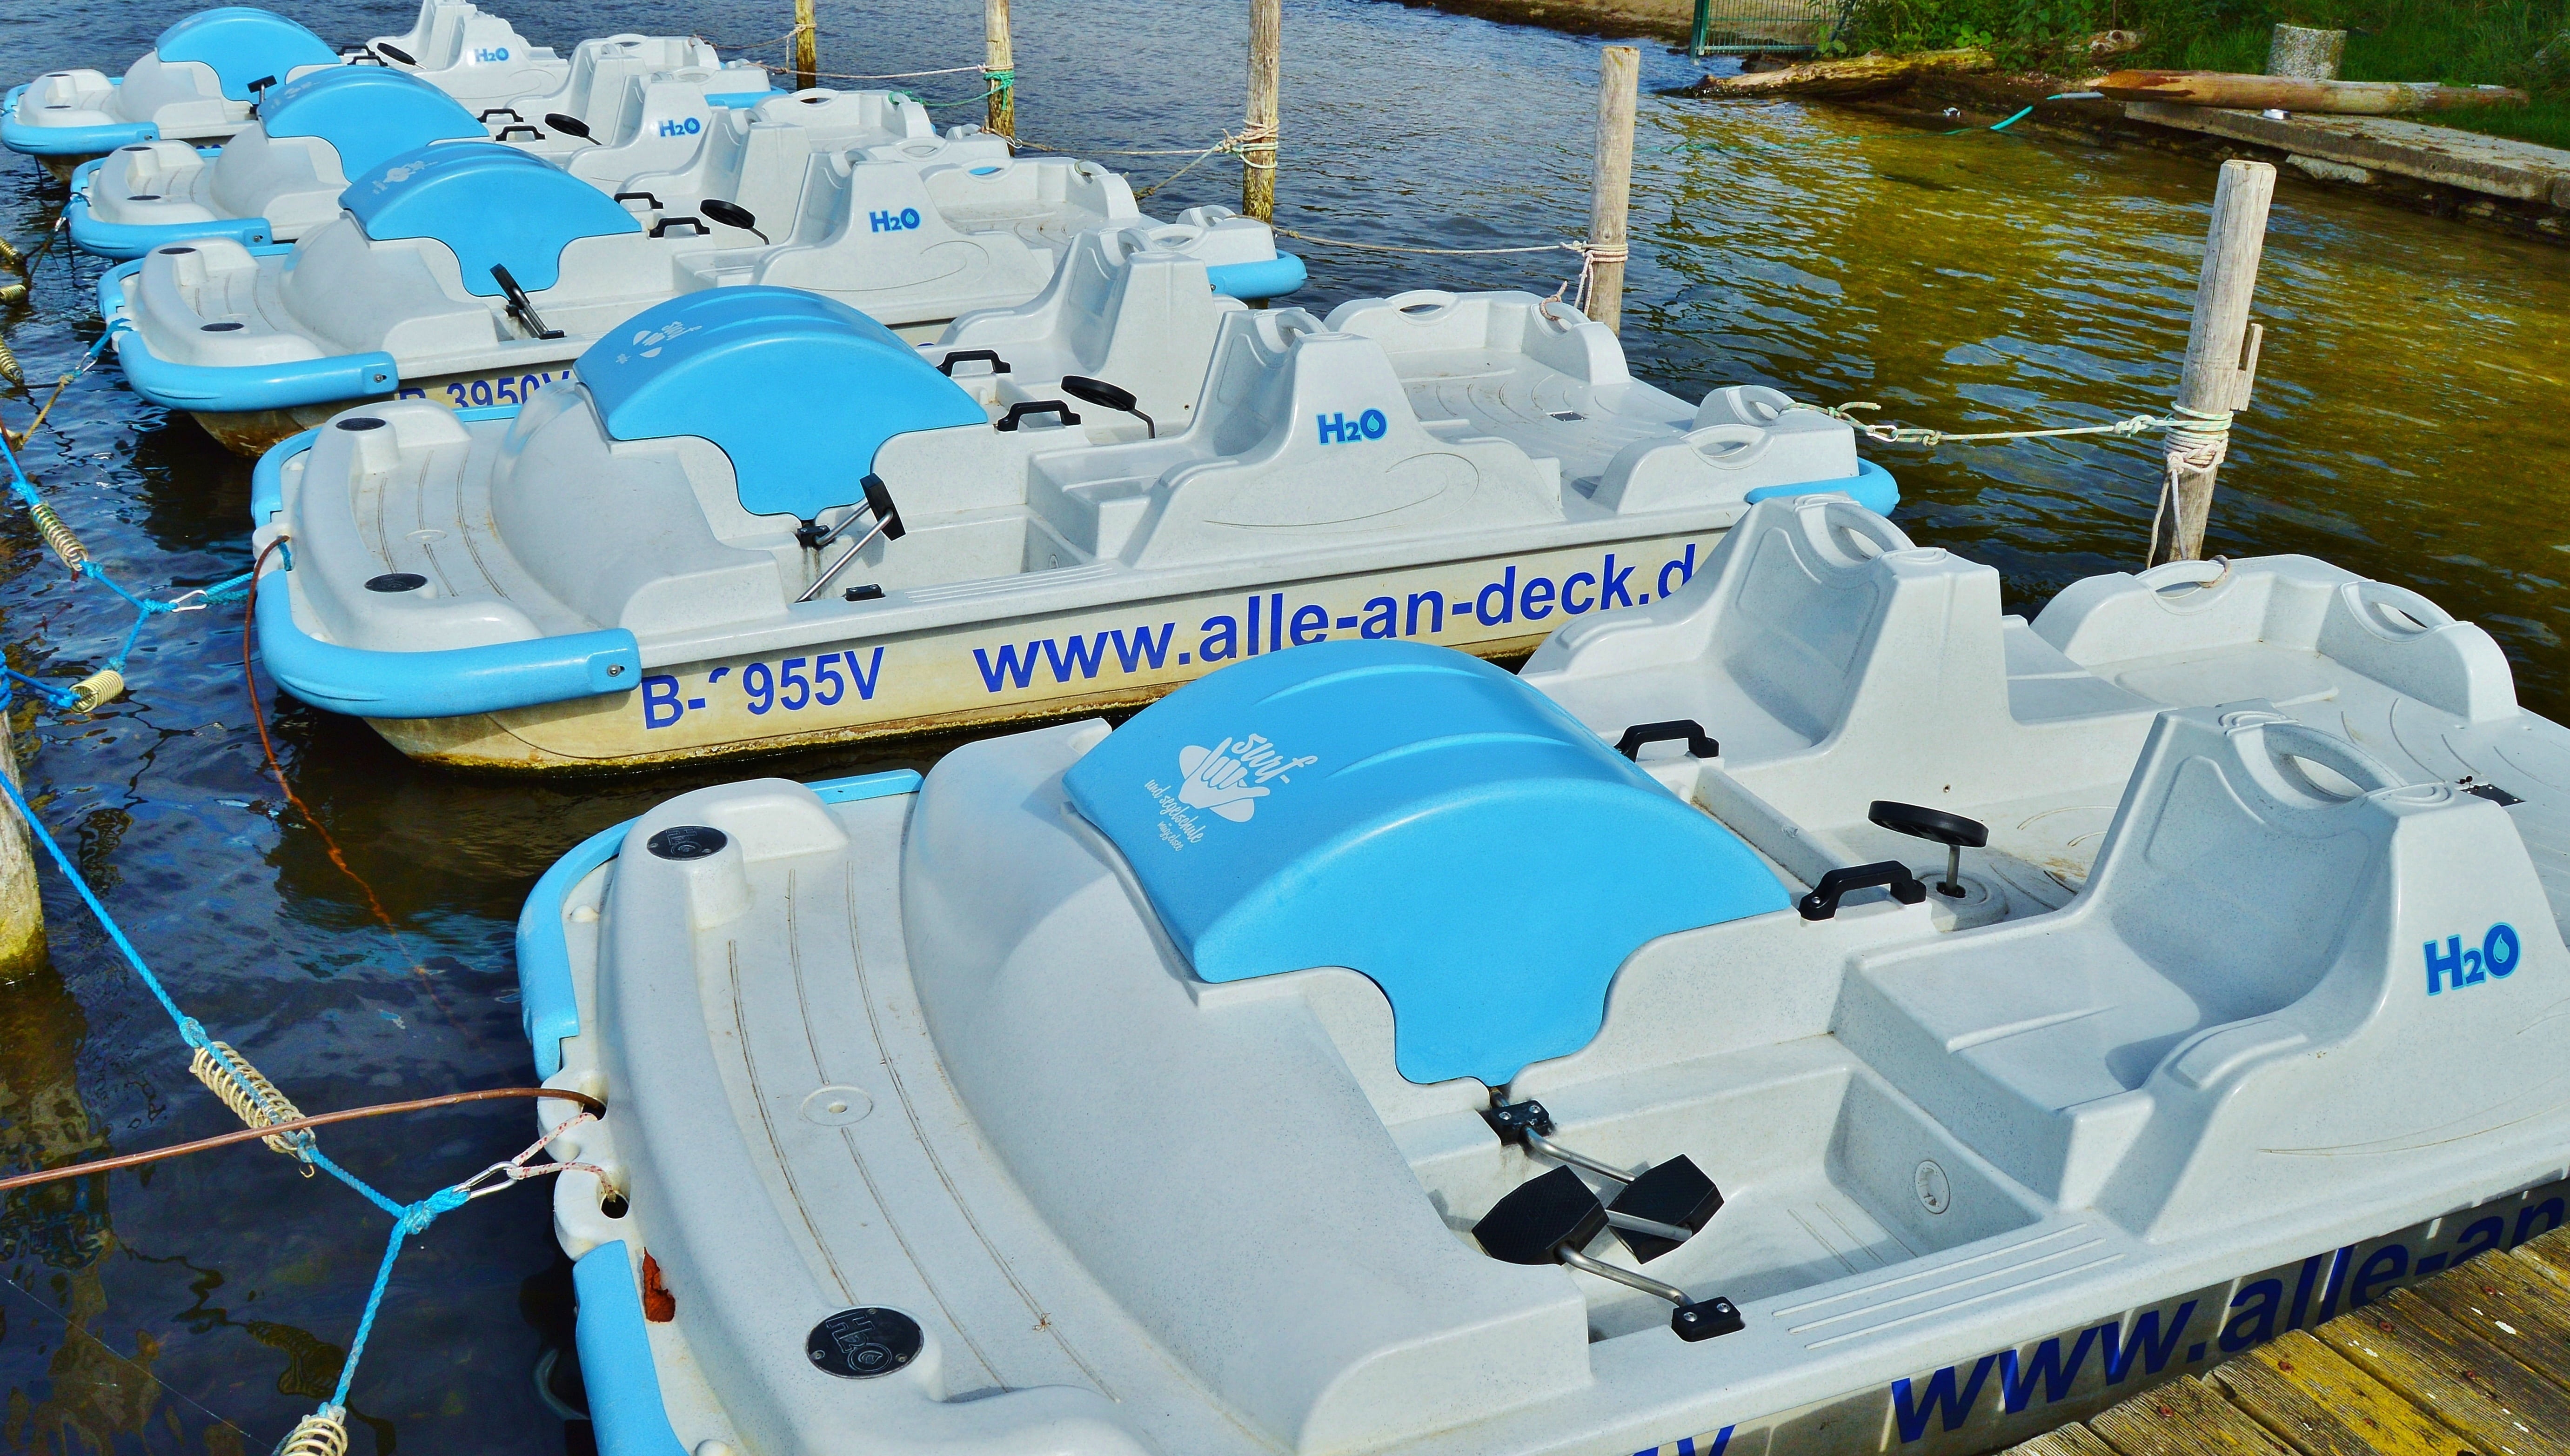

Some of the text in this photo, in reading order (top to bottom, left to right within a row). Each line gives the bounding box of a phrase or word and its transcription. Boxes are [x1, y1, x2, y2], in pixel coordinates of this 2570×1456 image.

[474, 47, 509, 62] H2O
[657, 117, 700, 137] H2O
[869, 207, 920, 232] H2O
[1317, 408, 1386, 444] H2O
[2424, 924, 2519, 994] H2O
